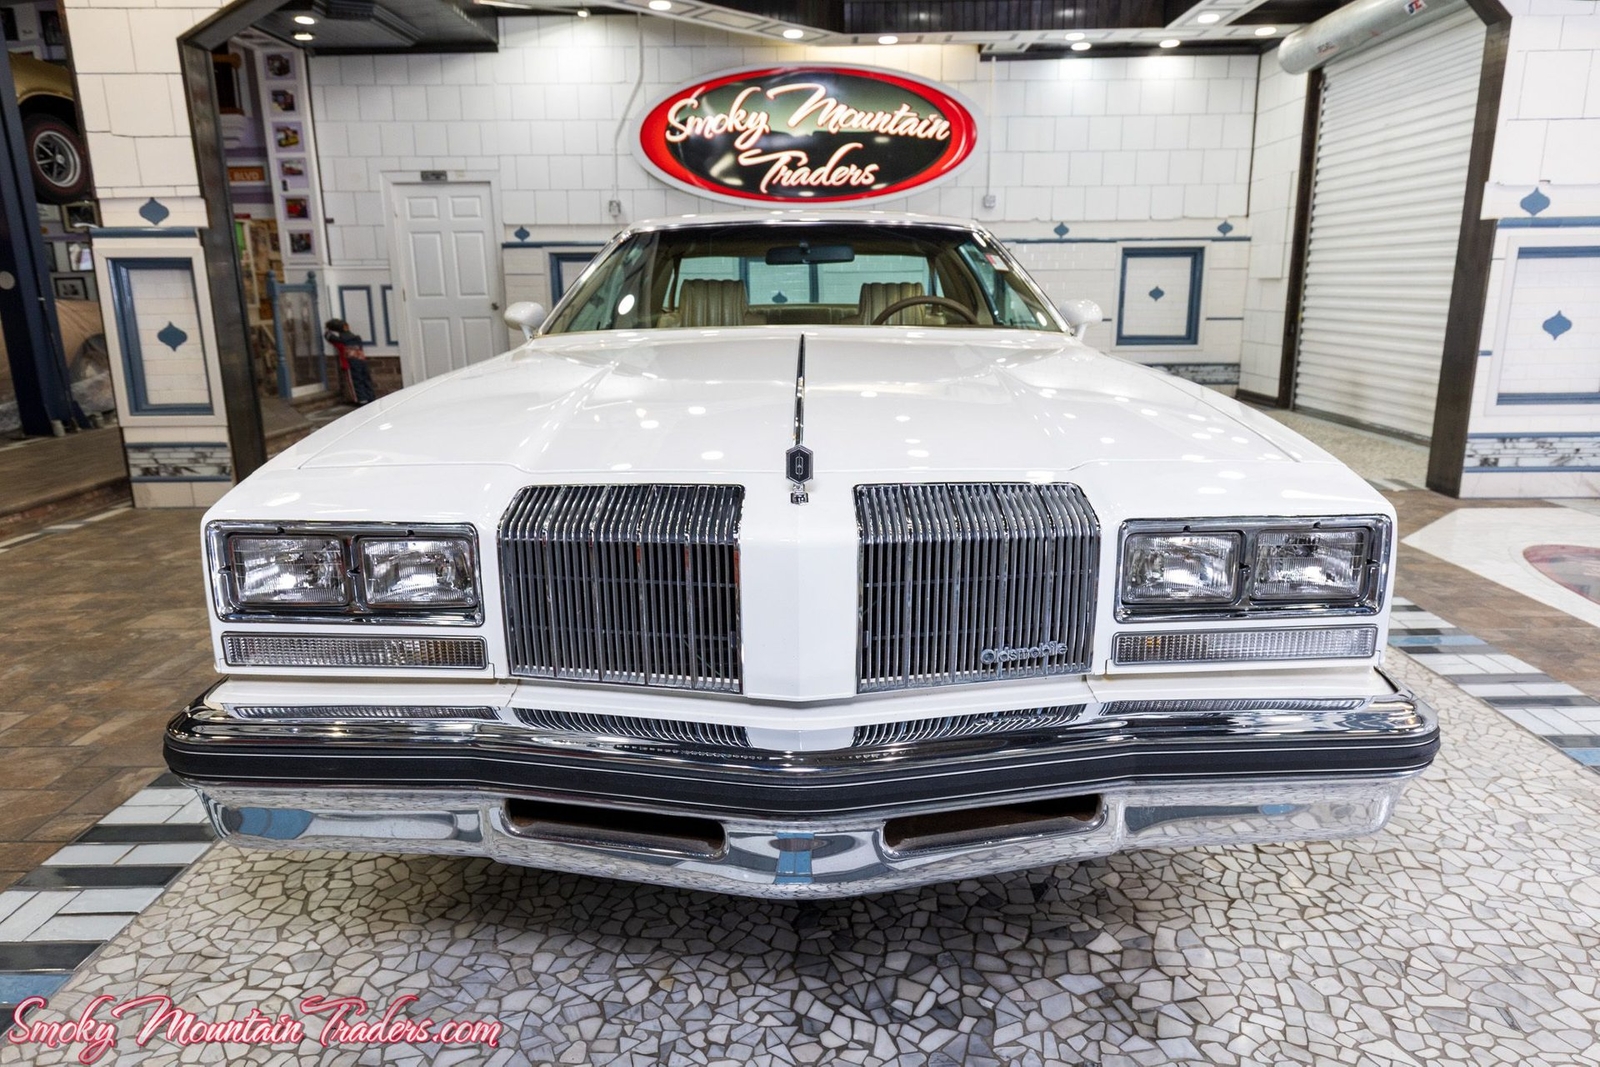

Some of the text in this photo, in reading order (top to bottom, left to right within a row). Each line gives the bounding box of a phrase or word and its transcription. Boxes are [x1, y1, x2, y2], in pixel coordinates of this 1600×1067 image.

[665, 83, 951, 150] Smoky Mountain
[738, 142, 879, 194] Traders
[980, 640, 1068, 665] Oldsmobile
